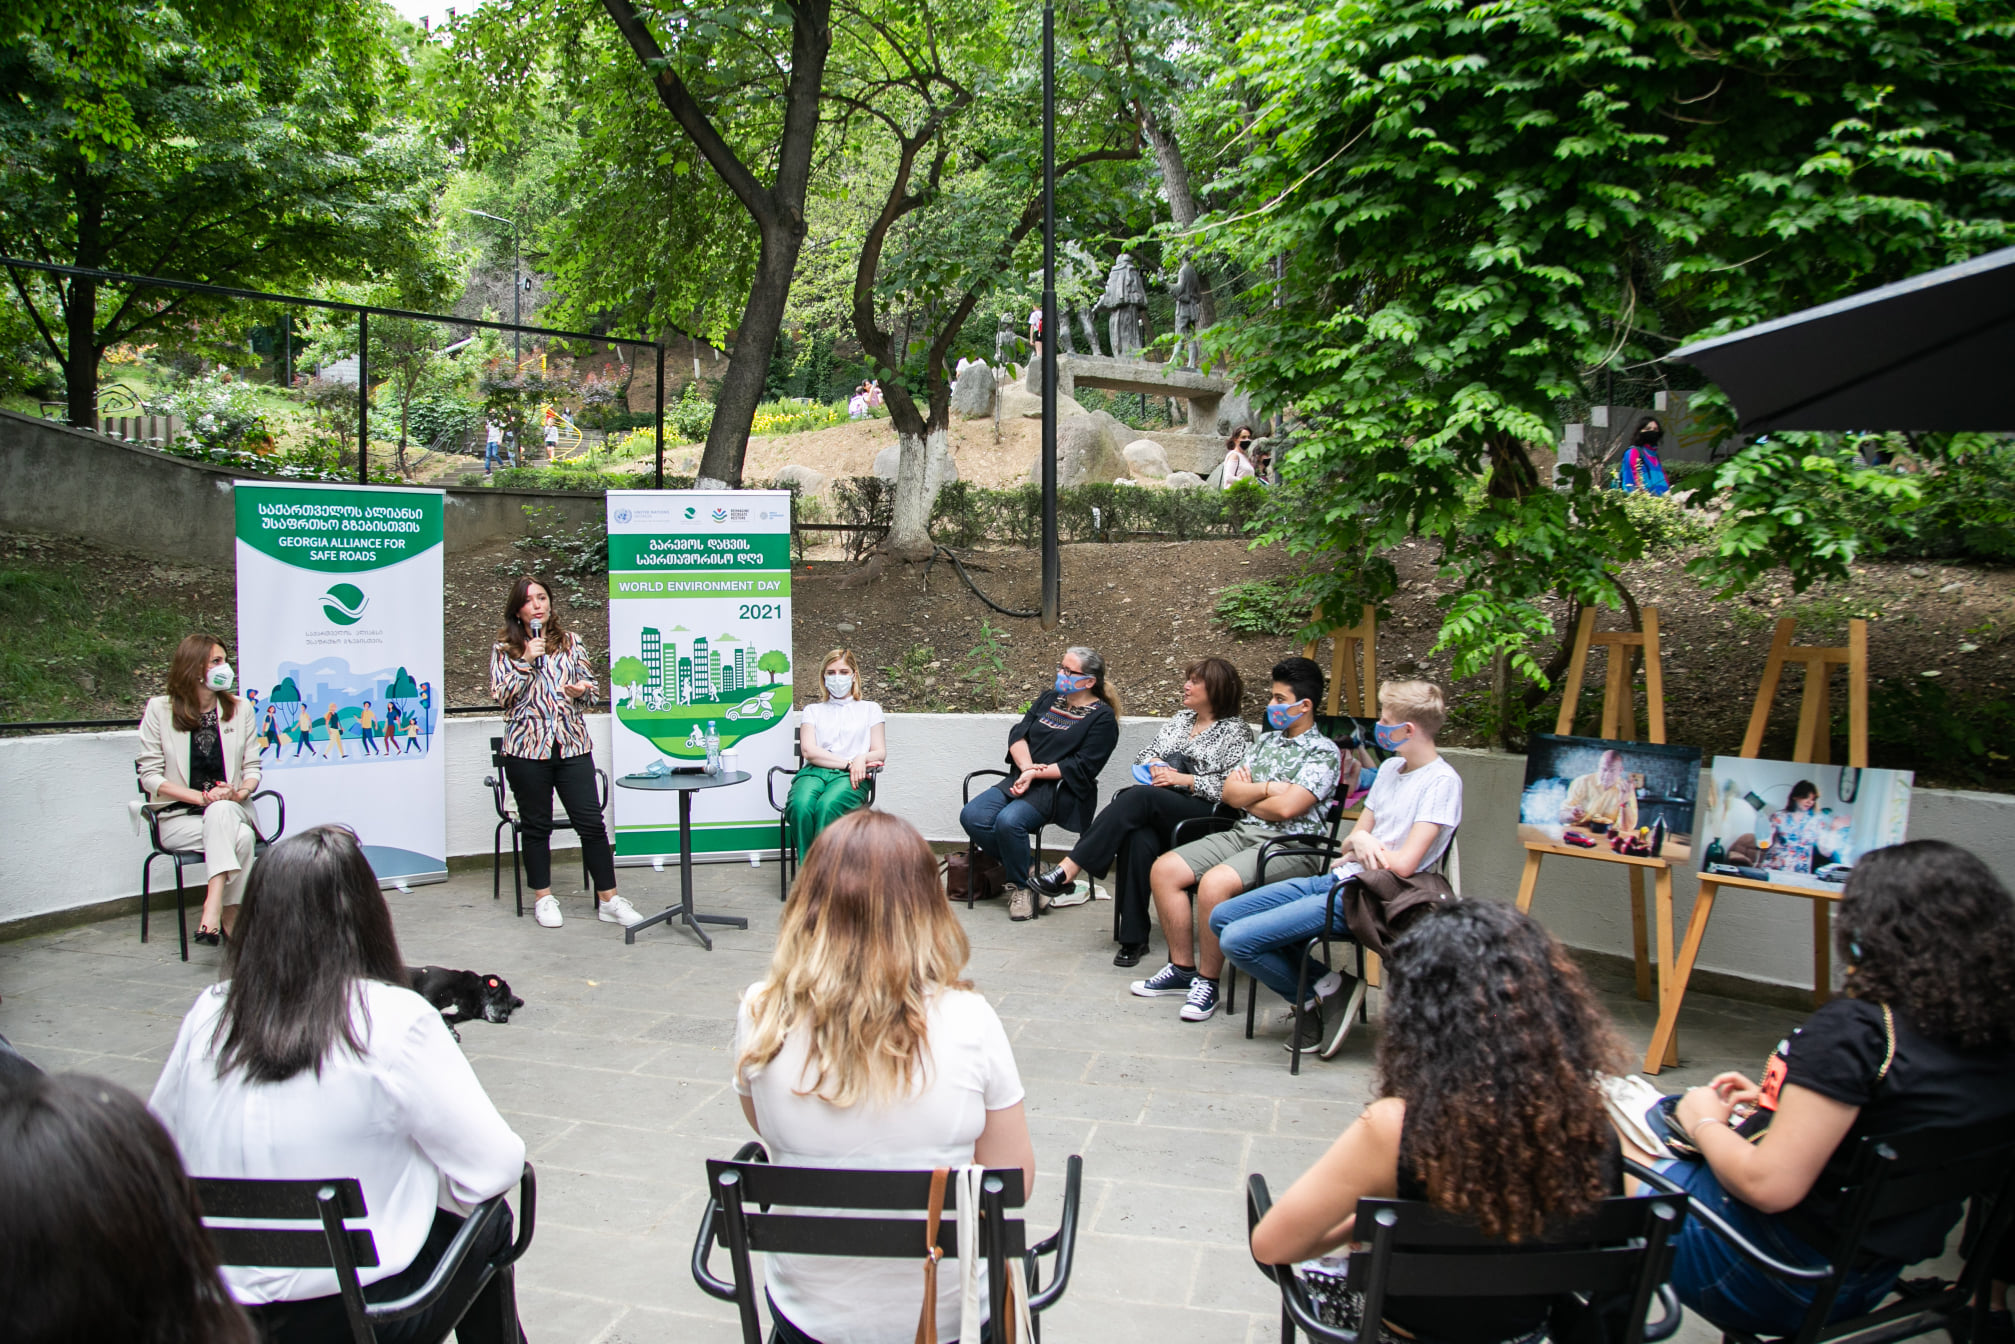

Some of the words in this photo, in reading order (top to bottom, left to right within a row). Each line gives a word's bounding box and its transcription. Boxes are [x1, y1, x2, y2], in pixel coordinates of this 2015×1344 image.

[279, 537, 328, 547] GEORGIA
[330, 538, 382, 548] ALLIANCE
[384, 539, 405, 548] FOR
[310, 551, 337, 560] SAFE
[339, 551, 376, 561] ROADS
[737, 553, 763, 564] დღე
[619, 582, 663, 592] WORLD
[667, 581, 754, 592] ENVIRONMENT
[758, 581, 781, 590] DAY
[739, 604, 782, 619] 2021
